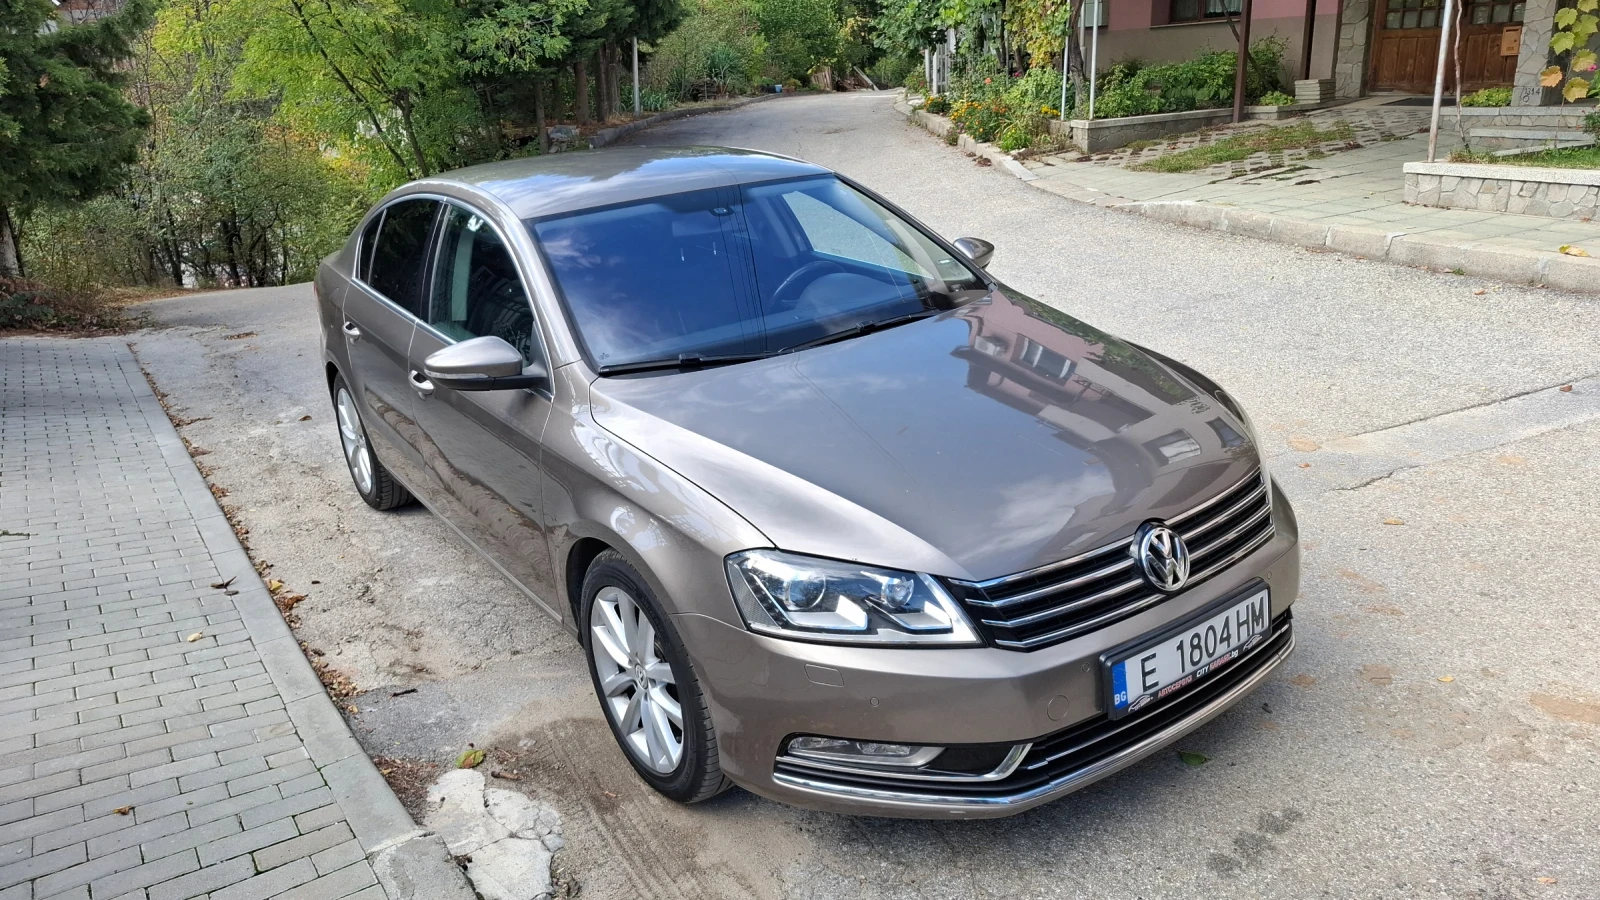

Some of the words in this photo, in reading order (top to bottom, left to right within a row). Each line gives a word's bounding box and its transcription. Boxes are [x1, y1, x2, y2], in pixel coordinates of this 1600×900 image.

[1140, 652, 1160, 693] E
[1176, 615, 1232, 674] 1804
[1236, 596, 1265, 643] HM
[1196, 665, 1210, 678] CITY
[1114, 690, 1127, 706] BG
